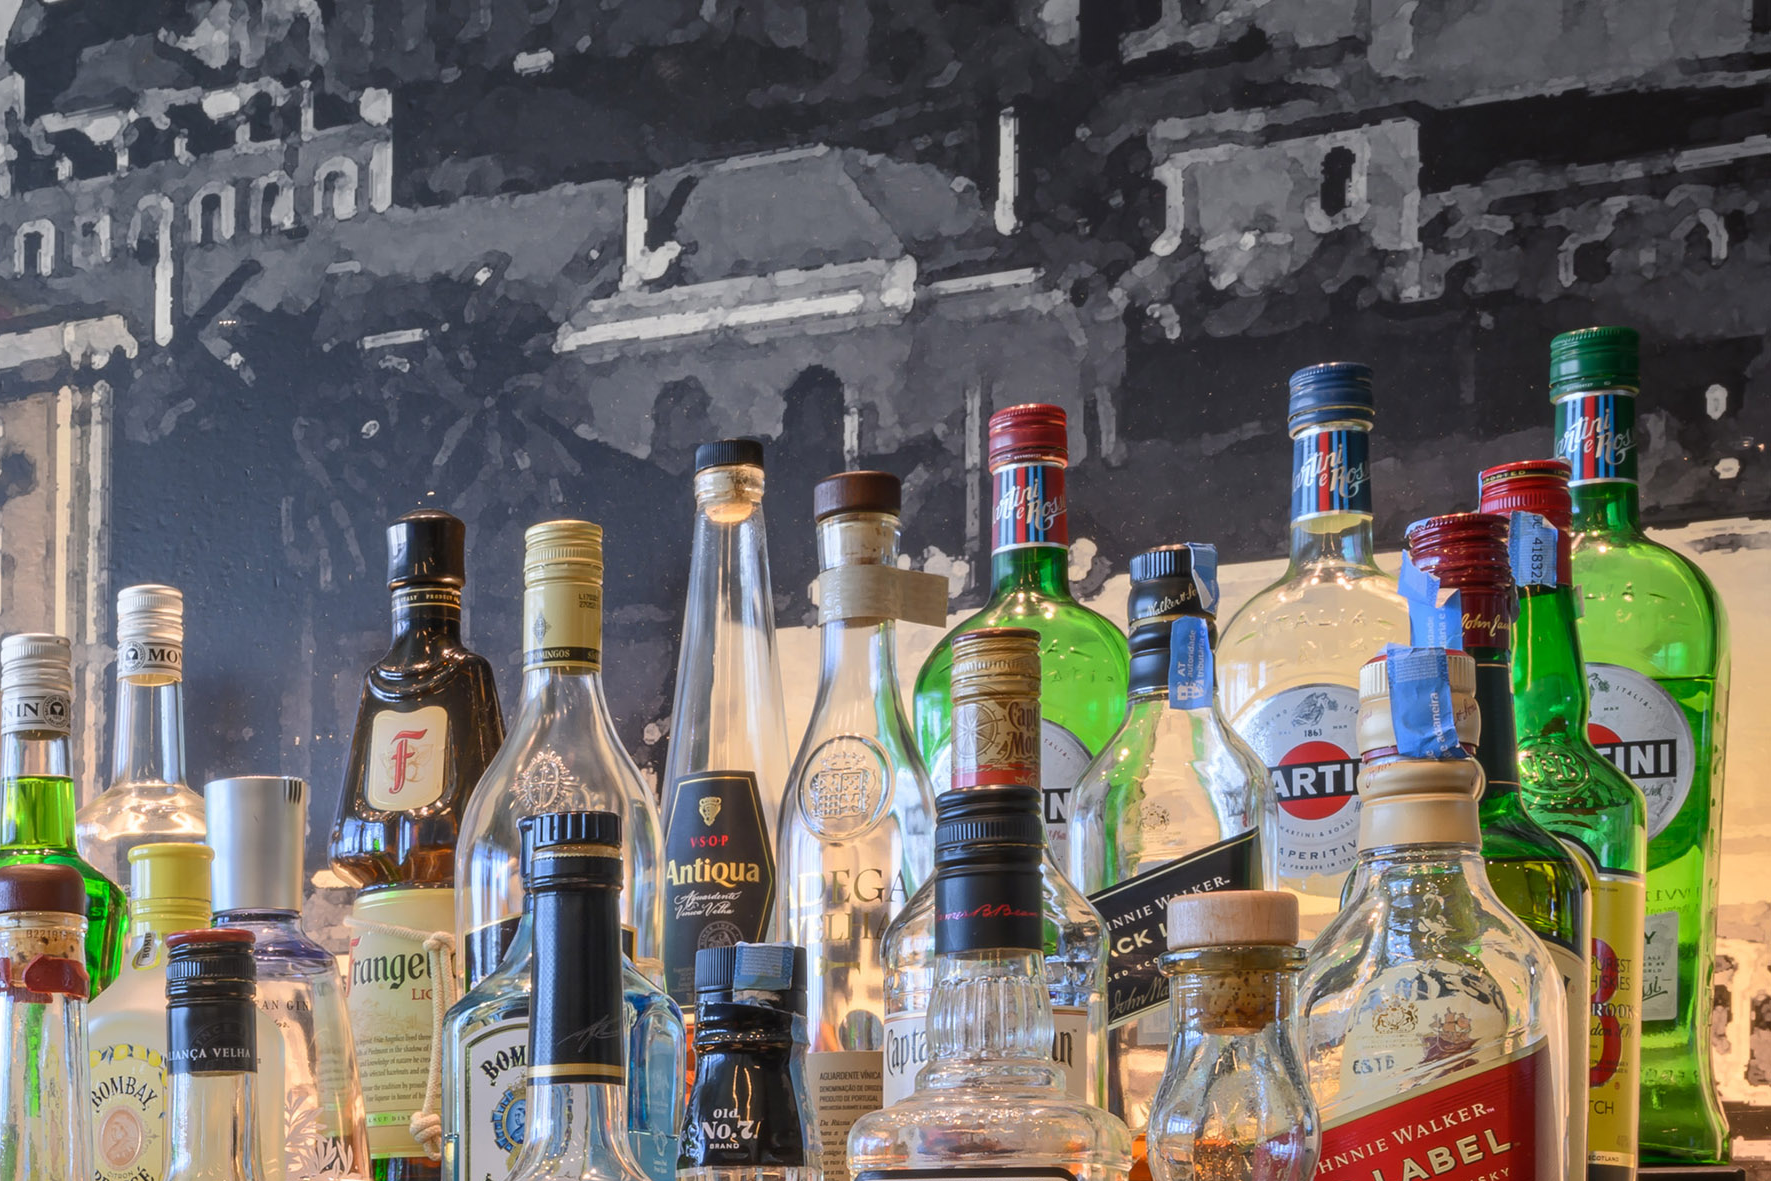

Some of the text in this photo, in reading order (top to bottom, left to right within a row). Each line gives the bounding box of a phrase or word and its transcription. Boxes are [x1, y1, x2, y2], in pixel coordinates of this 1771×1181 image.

[1187, 630, 1196, 681] autoridade
[1303, 729, 1322, 737] 1863
[667, 858, 760, 888] Antiqua
[286, 1001, 309, 1011] GIN
[213, 1048, 250, 1058] VELHA
[91, 1076, 157, 1112] BOMBAY
[713, 1108, 739, 1119] Old
[1392, 1103, 1488, 1144] WALKER
